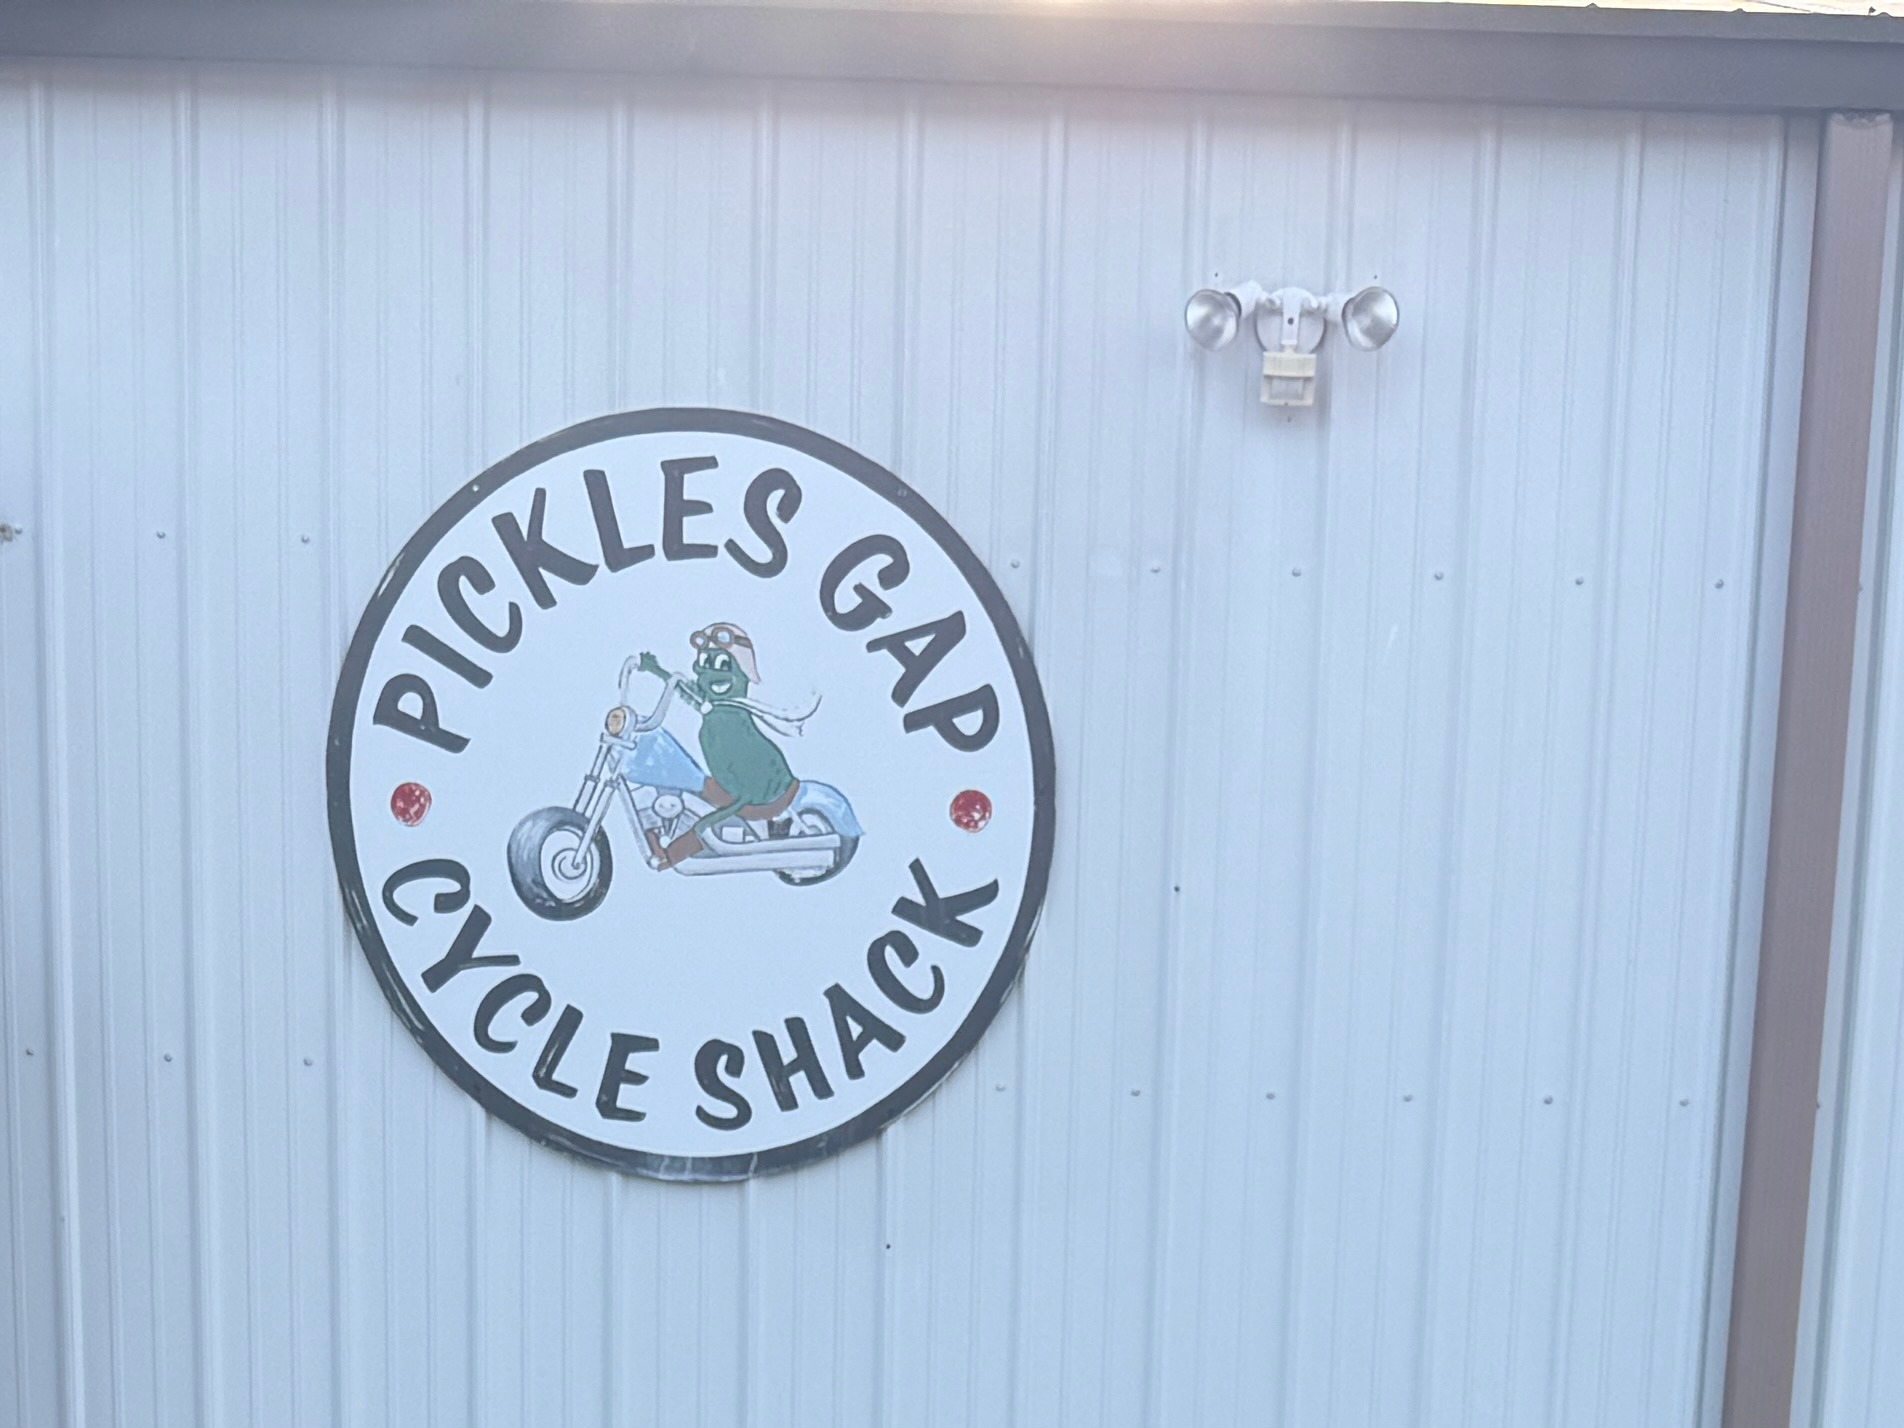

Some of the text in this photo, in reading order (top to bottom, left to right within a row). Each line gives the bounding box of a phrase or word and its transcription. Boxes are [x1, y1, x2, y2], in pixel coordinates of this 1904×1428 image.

[373, 455, 1000, 754] PICKLES GAP
[381, 857, 1000, 1131] CYCLE SHACK
